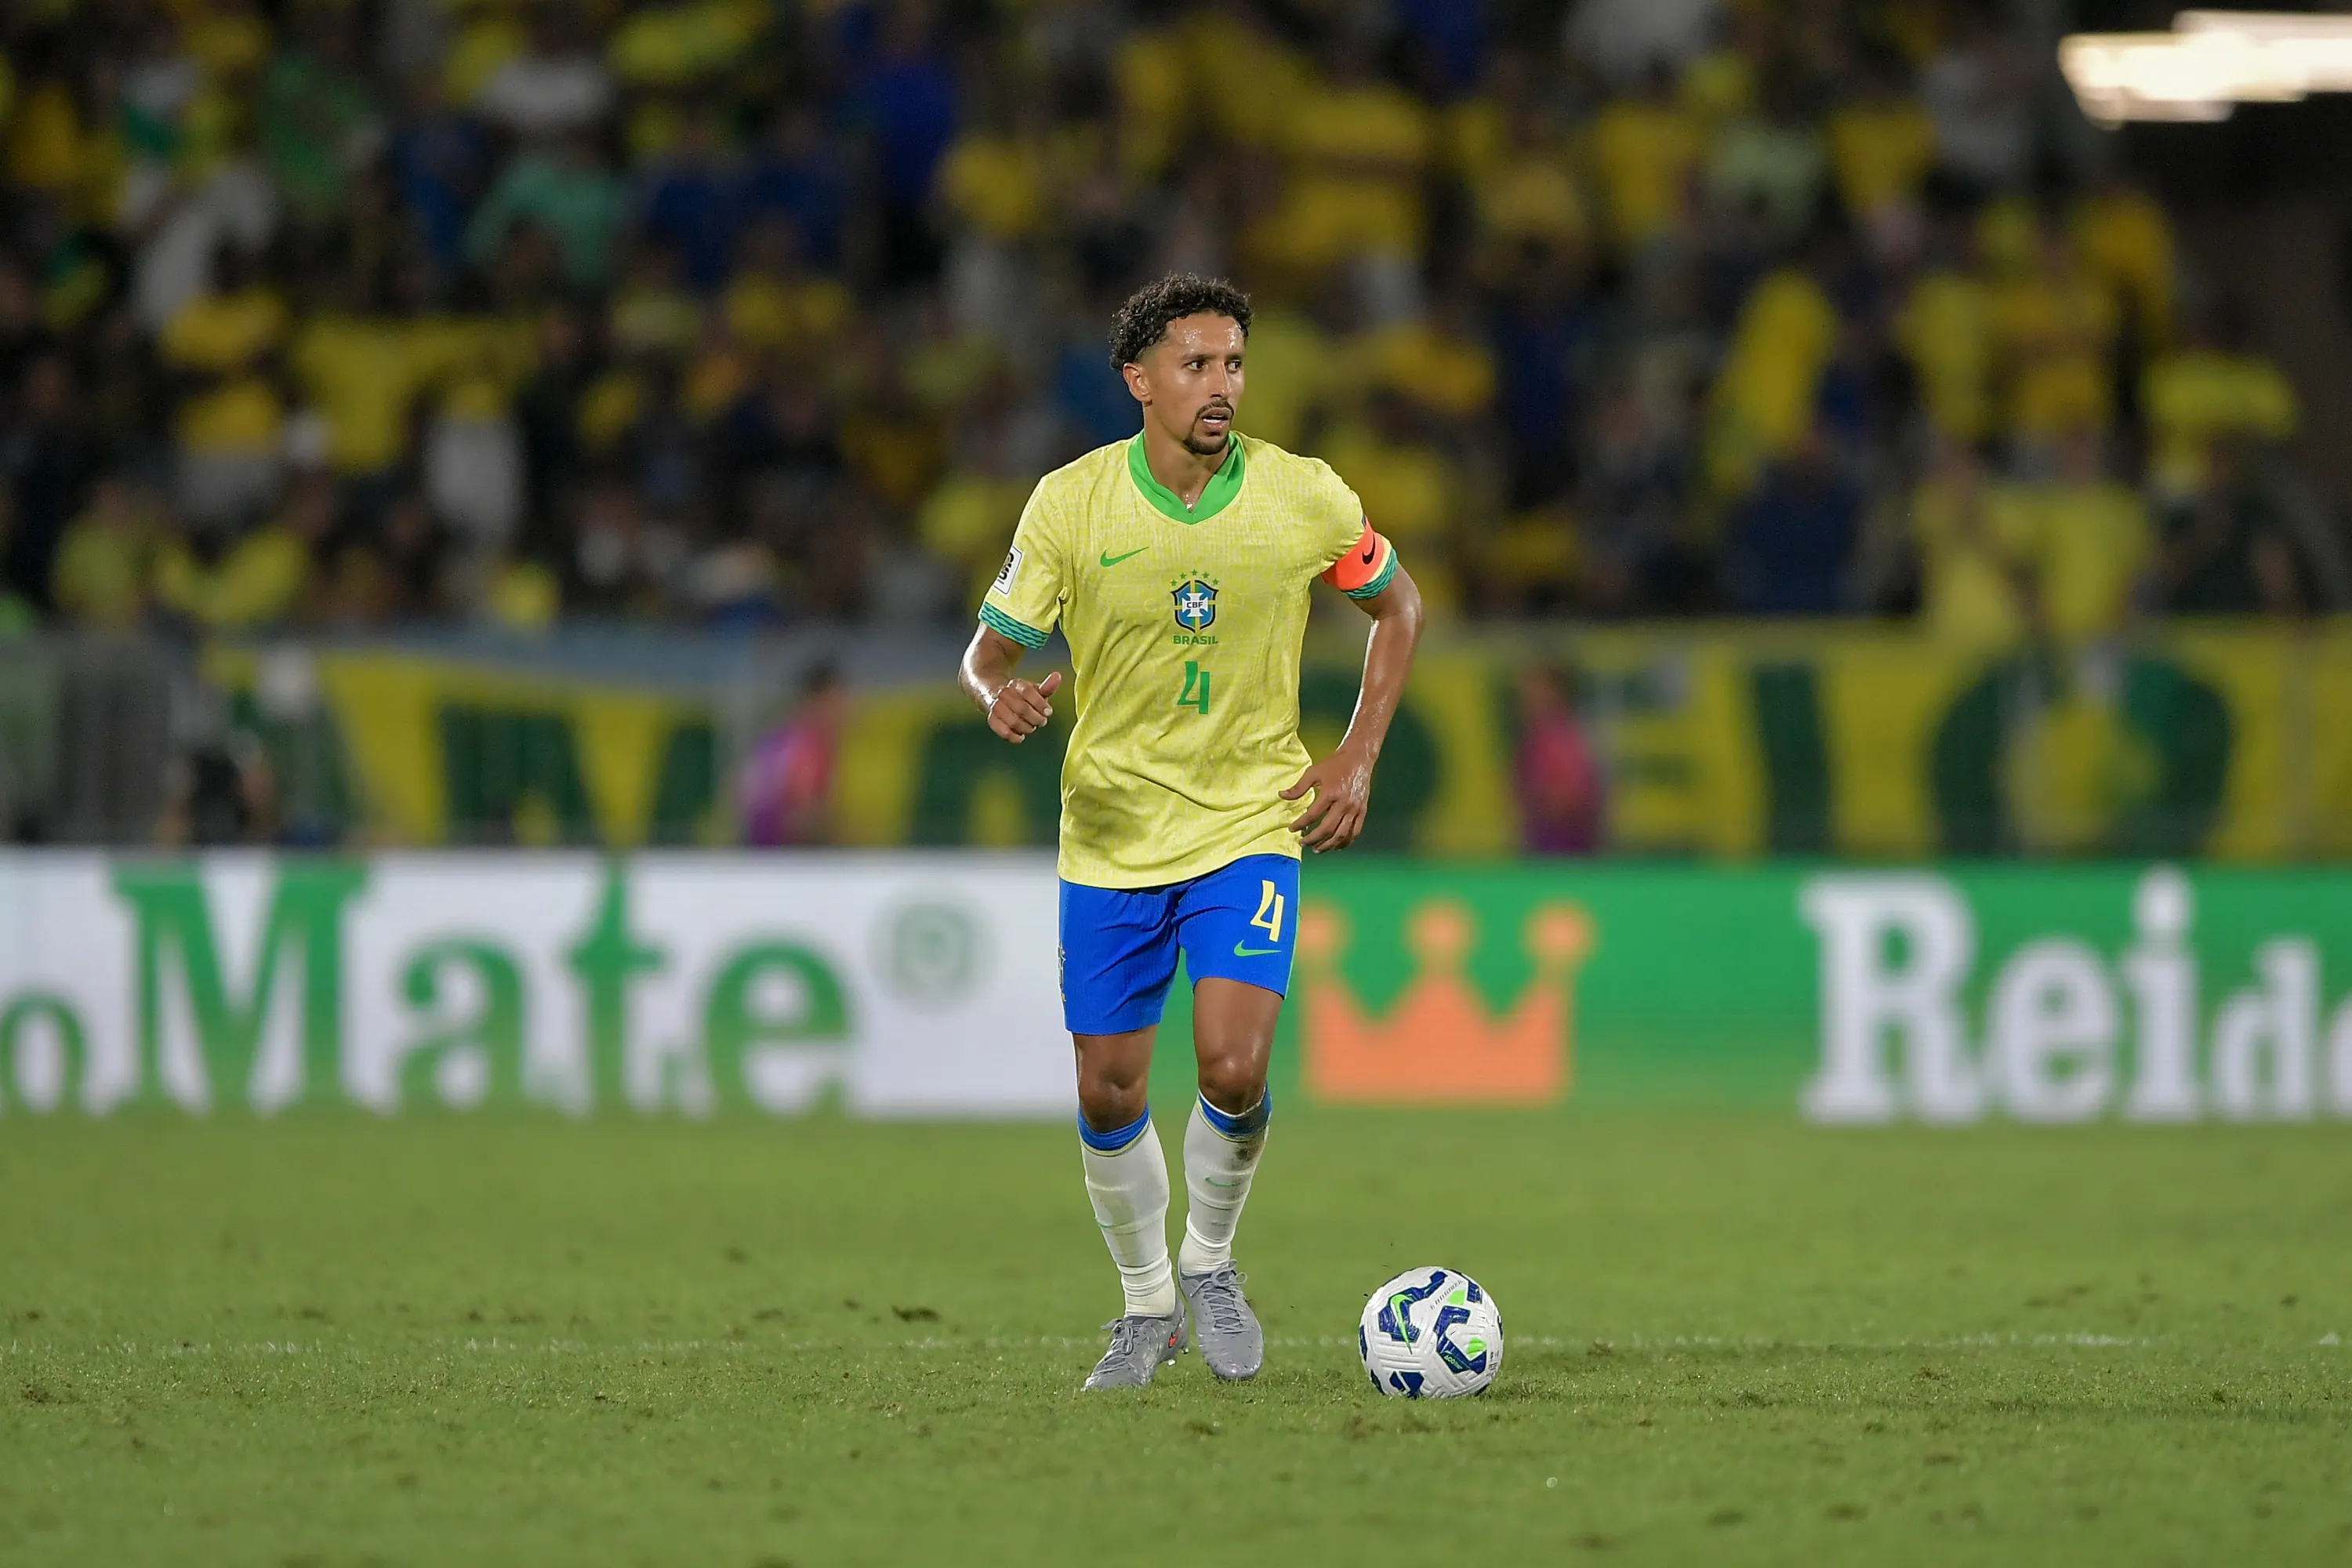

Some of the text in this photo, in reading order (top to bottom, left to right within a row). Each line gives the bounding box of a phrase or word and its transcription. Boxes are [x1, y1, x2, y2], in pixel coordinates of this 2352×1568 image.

[1173, 635, 1218, 644] BRASIL
[1176, 661, 1210, 714] 4
[1250, 880, 1284, 942] 4
